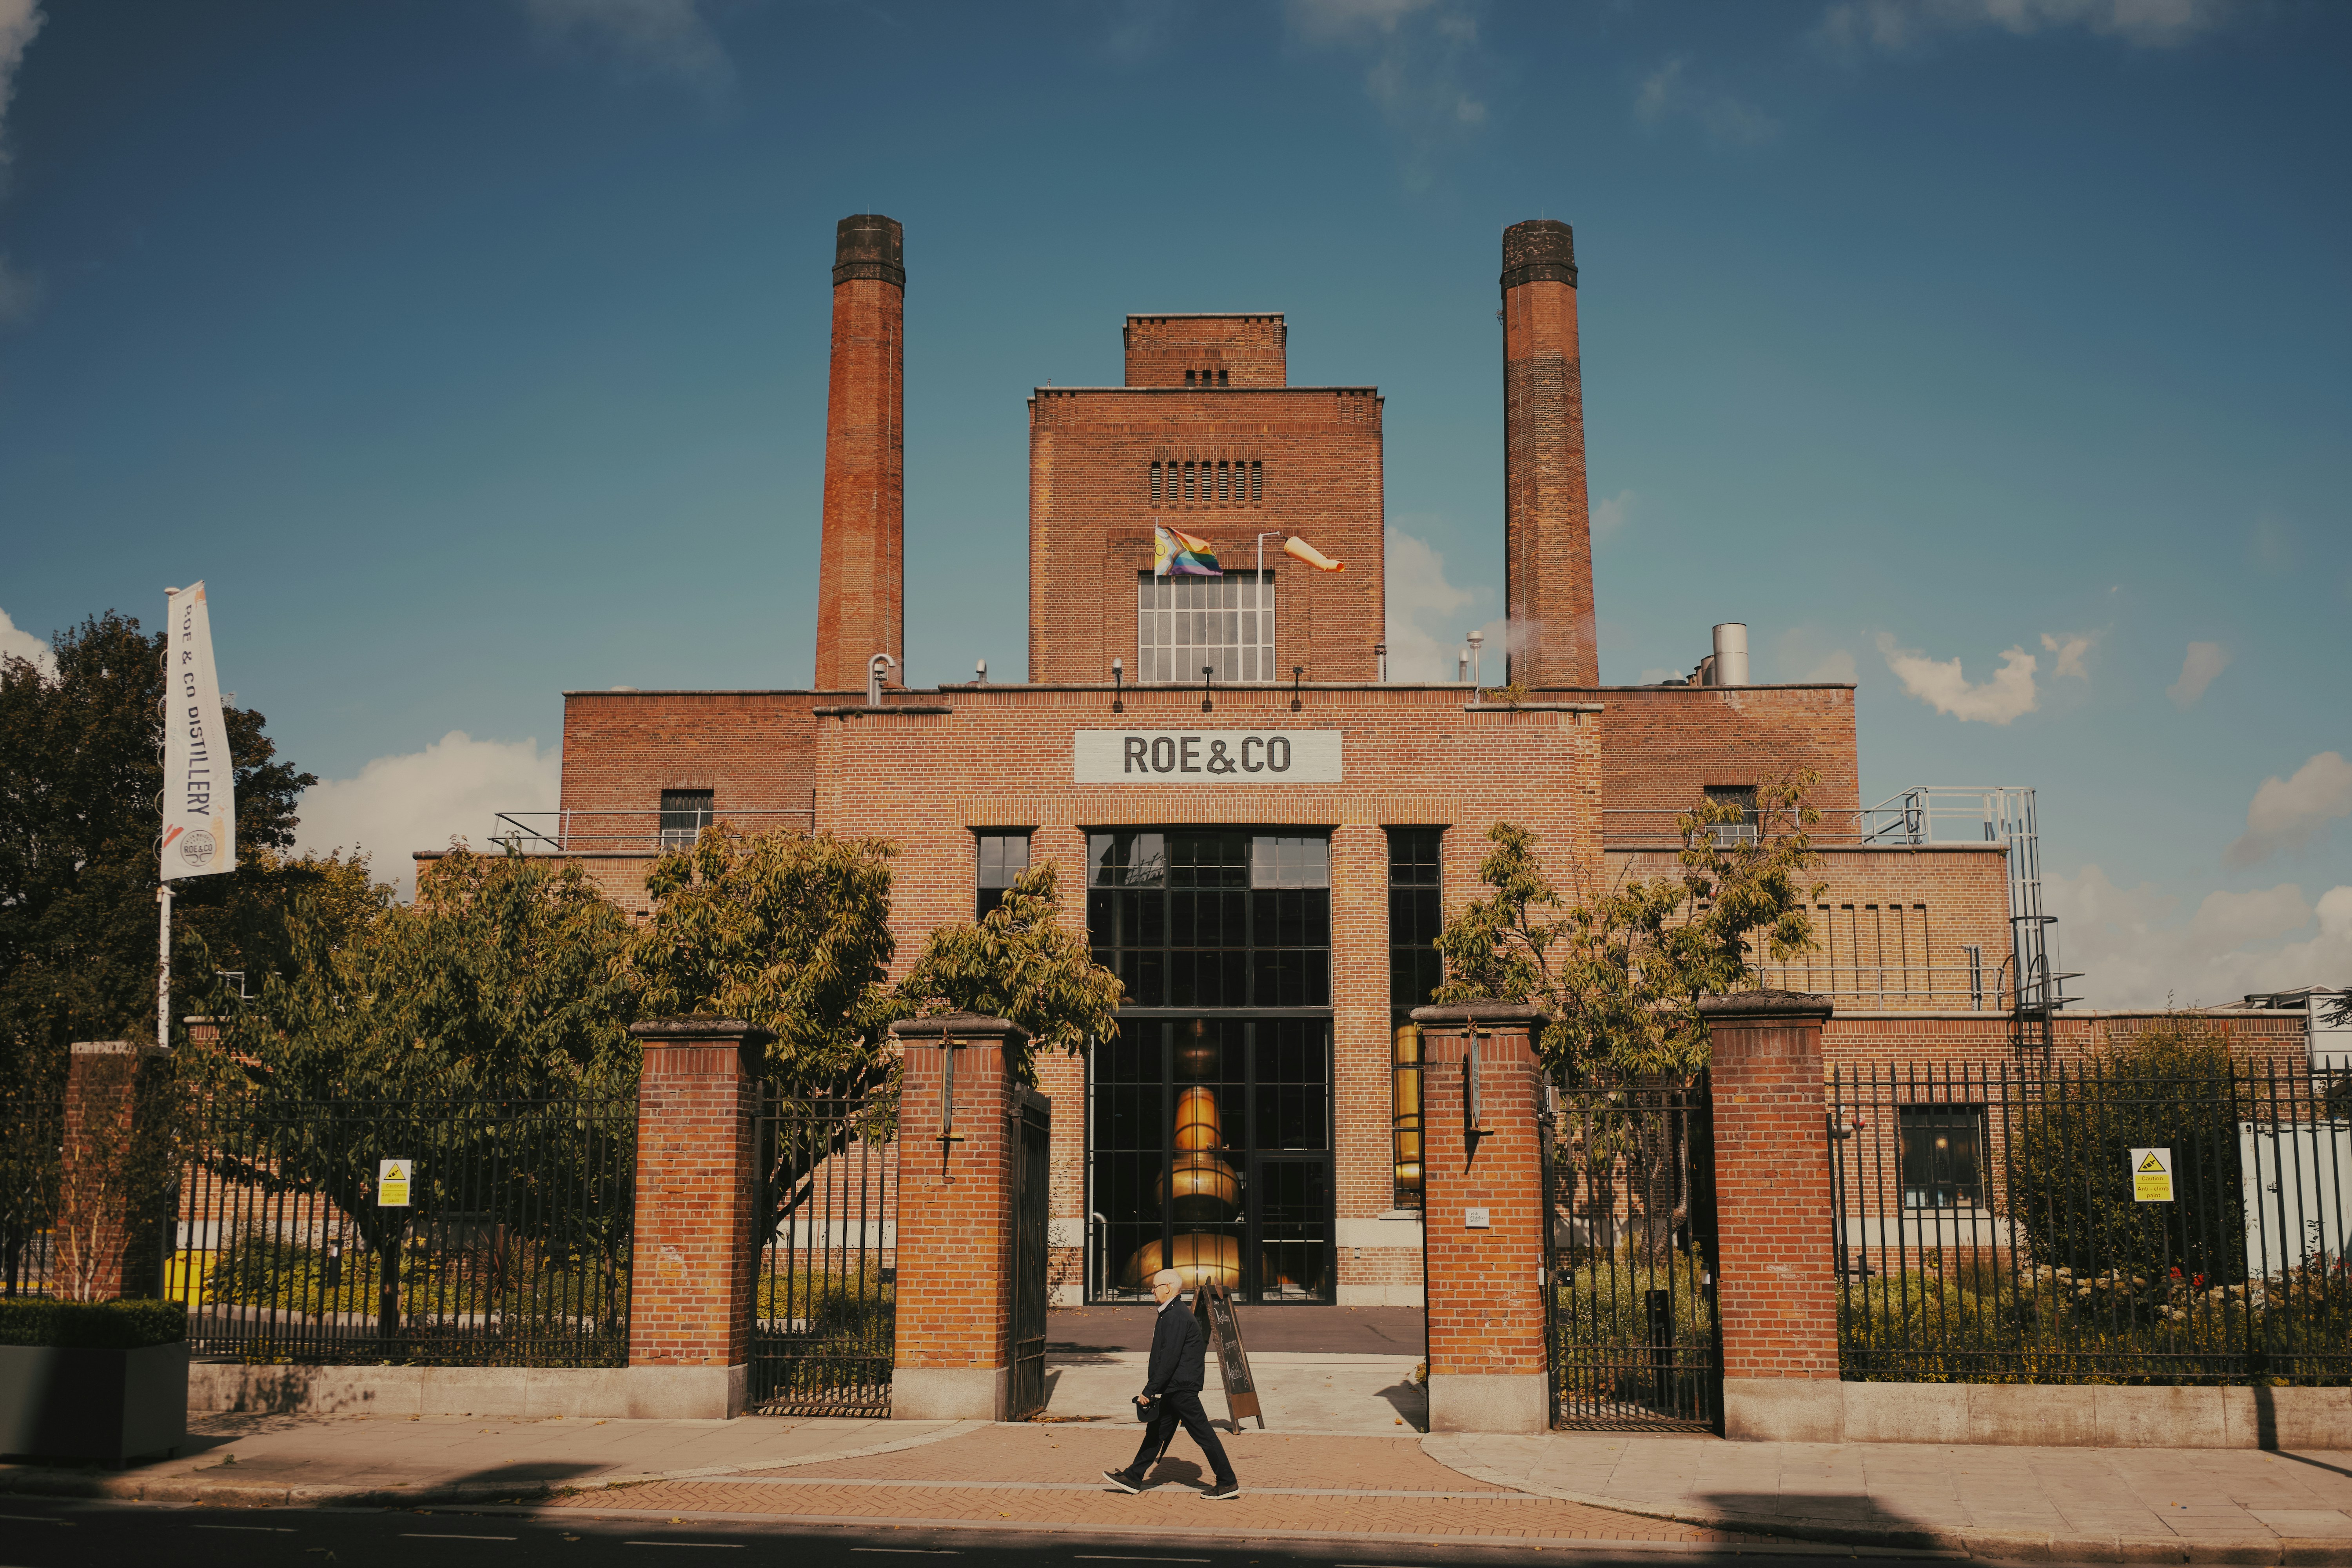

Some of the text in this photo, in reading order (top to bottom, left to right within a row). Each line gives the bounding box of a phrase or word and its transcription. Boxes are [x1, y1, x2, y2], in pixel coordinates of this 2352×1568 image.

[182, 651, 192, 665] &
[183, 672, 195, 698] CO
[187, 706, 210, 815] DISTILLERY
[1125, 736, 1290, 775] ROE&CO
[184, 844, 212, 853] ROE&CO
